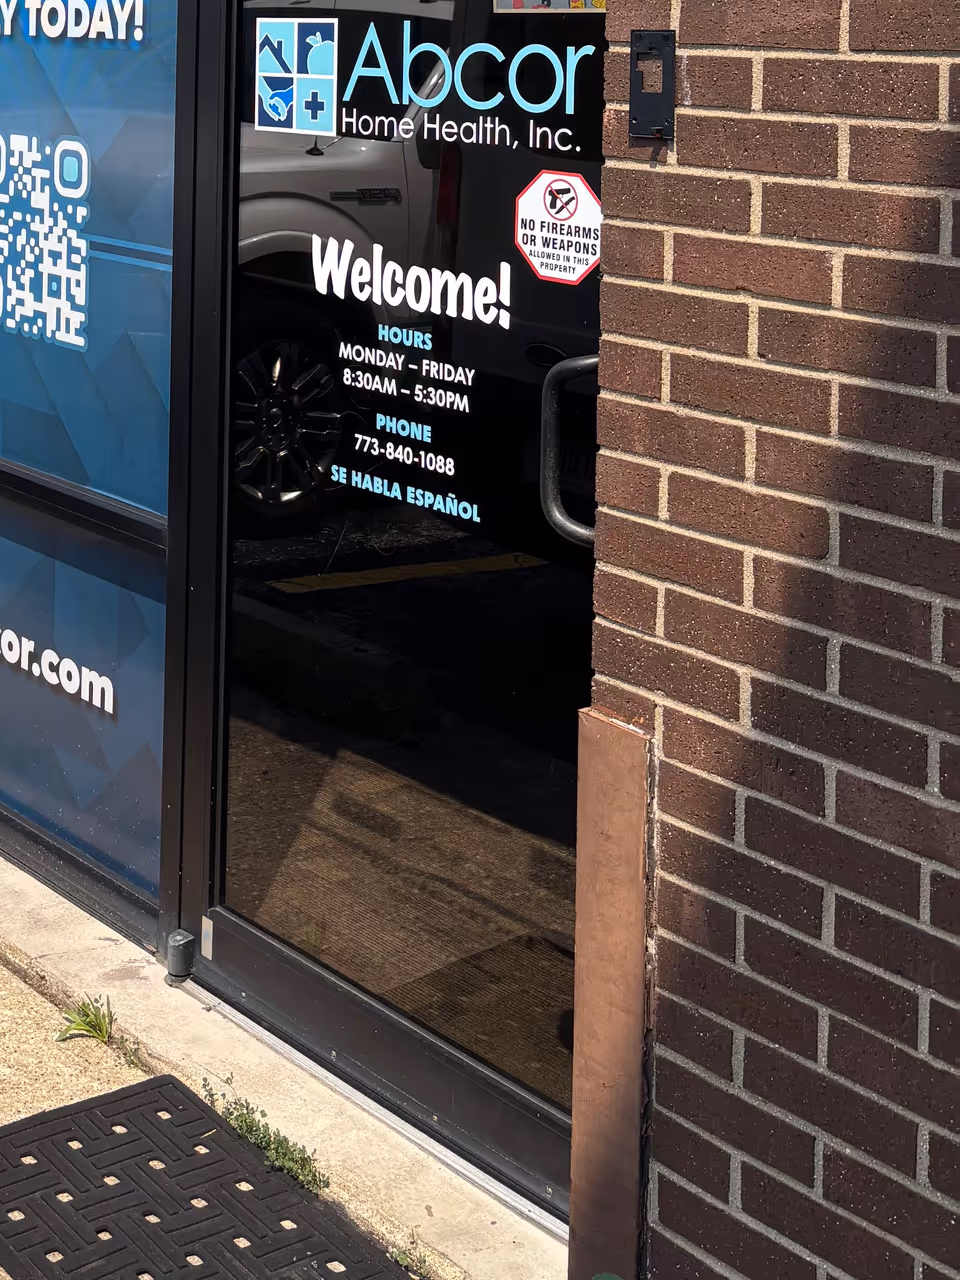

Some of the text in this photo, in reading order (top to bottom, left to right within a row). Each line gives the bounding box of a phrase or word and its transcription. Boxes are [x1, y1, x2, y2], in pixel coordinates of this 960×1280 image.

[342, 20, 596, 115] Abcor
[342, 108, 581, 152] Home Health, Inc.
[521, 218, 599, 241] NO FIREARMS
[522, 233, 597, 256] OR WEAPONS
[529, 250, 589, 266] ALLOWED IN THIS
[540, 262, 576, 274] PROPERTY
[311, 234, 511, 330] Welcome!
[378, 324, 432, 350] HOURS
[339, 342, 405, 371] MONDAY
[422, 359, 475, 386] FRIDAY
[343, 368, 397, 396] 8:30AM
[414, 385, 469, 413] 5:30PM
[376, 413, 432, 443] PHONE
[354, 434, 455, 476] 773-840-1088
[331, 465, 481, 523] SE HABLA ESPAÑOL
